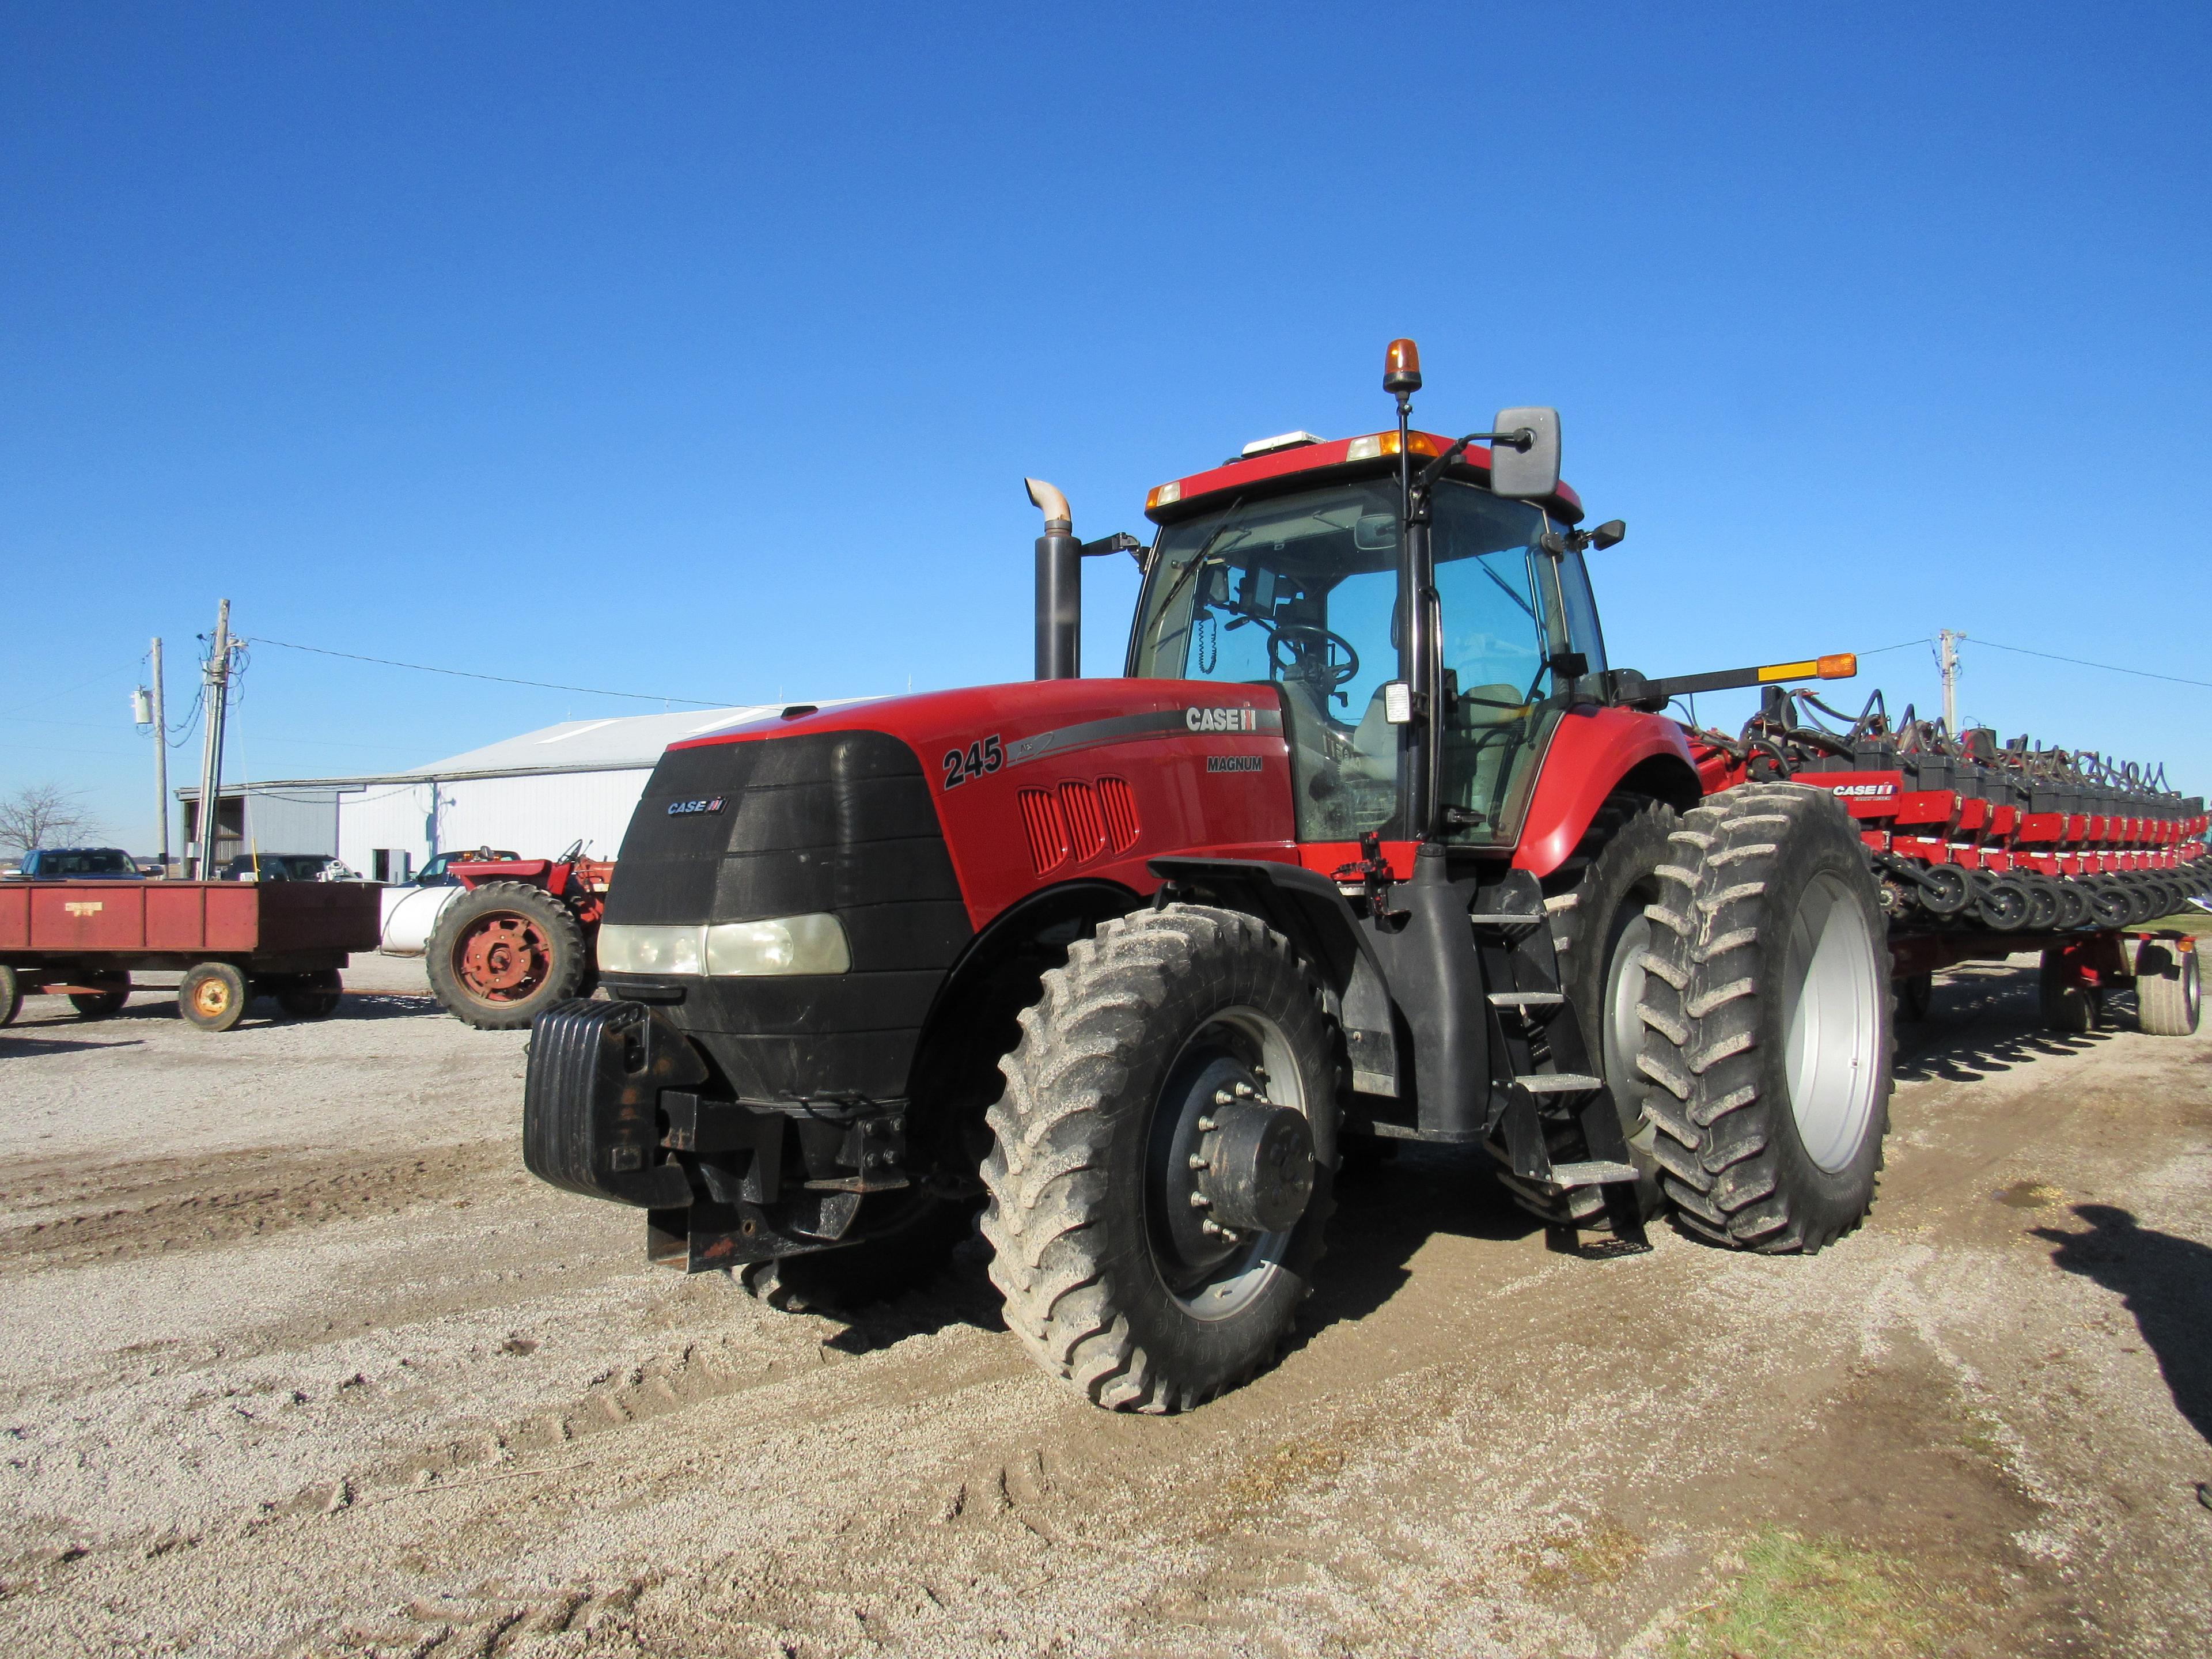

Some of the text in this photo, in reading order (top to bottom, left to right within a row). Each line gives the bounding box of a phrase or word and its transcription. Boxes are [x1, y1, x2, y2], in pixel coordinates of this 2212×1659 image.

[1186, 707, 1238, 732] CASE
[943, 733, 1003, 791] 245
[1207, 756, 1262, 772] MAGNUM
[1833, 785, 1877, 796] CASE
[668, 801, 706, 815] CASE
